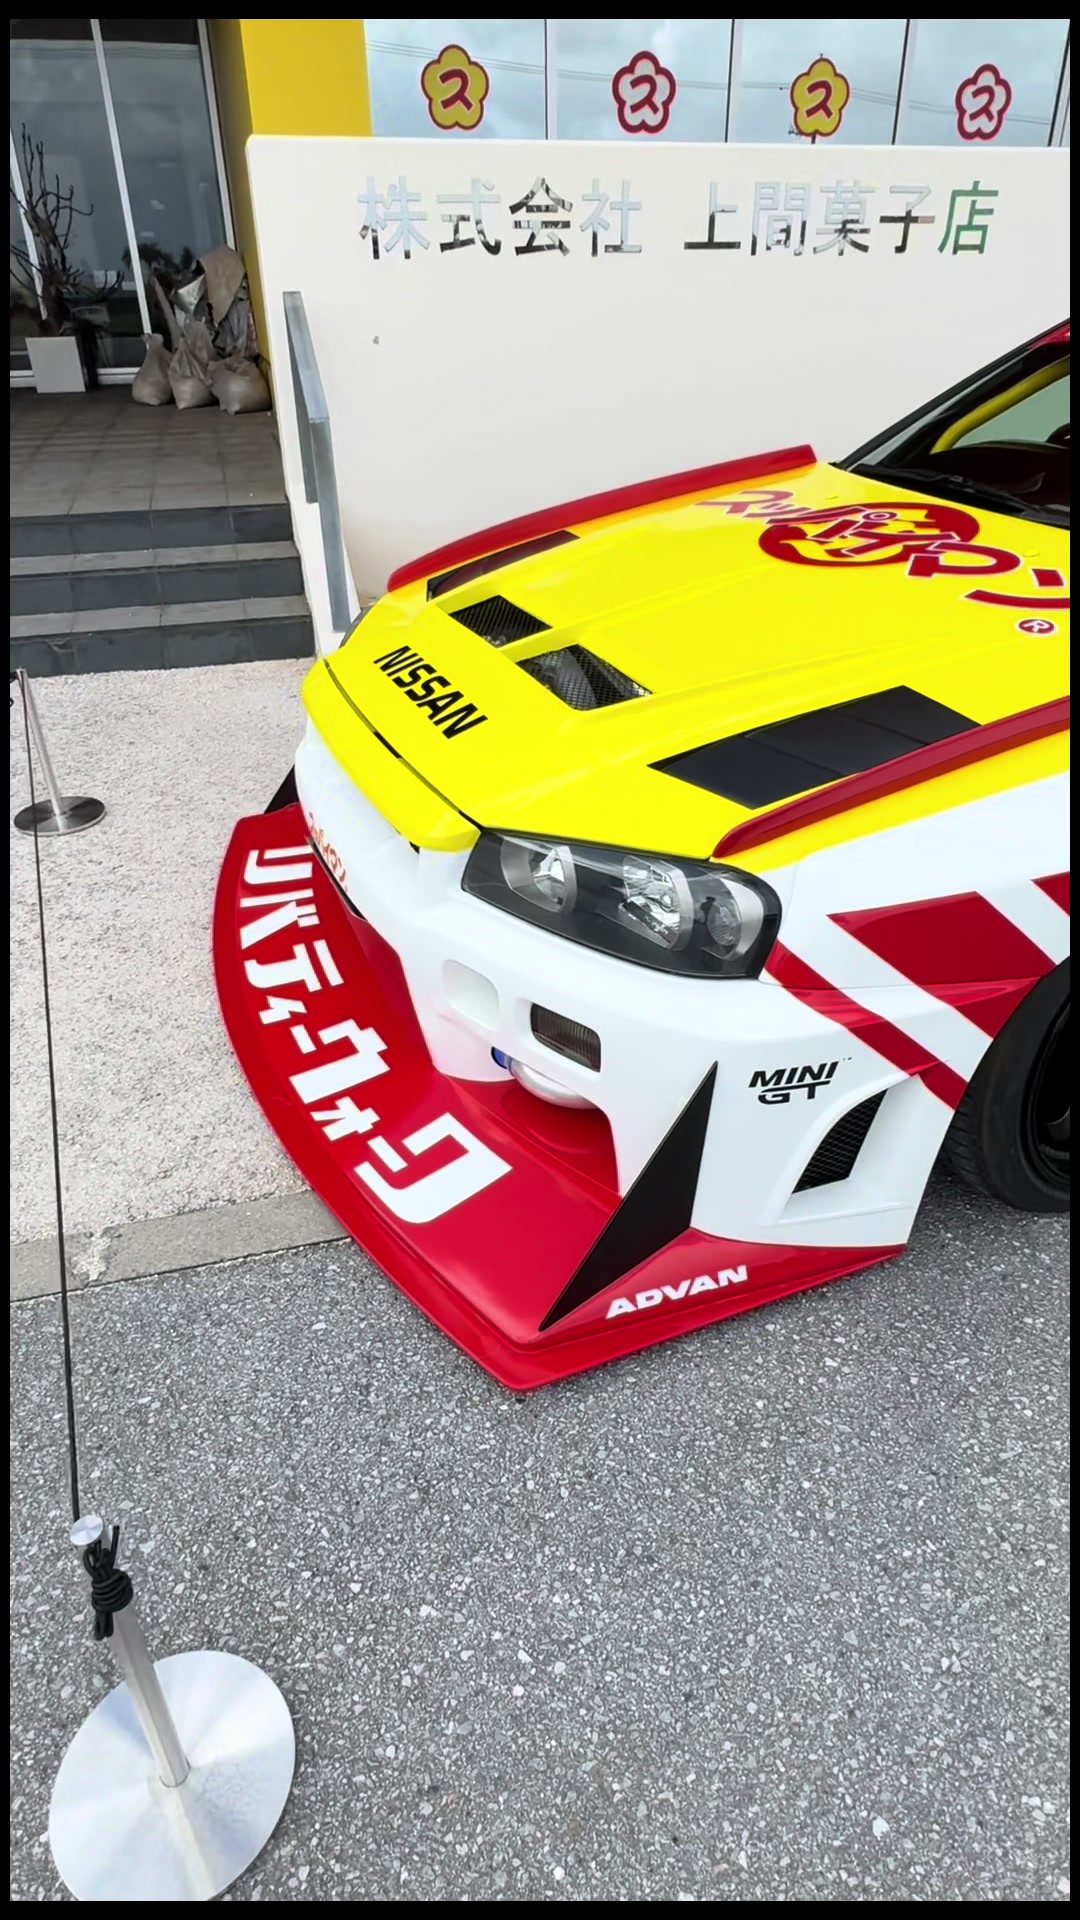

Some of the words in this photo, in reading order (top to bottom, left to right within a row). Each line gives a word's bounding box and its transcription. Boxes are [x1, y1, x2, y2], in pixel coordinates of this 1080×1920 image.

[438, 68, 474, 112] ス
[629, 74, 660, 115] ス
[805, 80, 834, 119] ス
[968, 85, 996, 123] ス
[357, 175, 643, 260] 株式会社
[683, 179, 999, 257] 上間菓子店
[373, 645, 489, 740] NISSAN
[239, 846, 513, 1224] リバティーウォーク
[749, 1060, 839, 1088] MINI
[758, 1080, 831, 1105] GT
[605, 1264, 749, 1320] ADVAN
